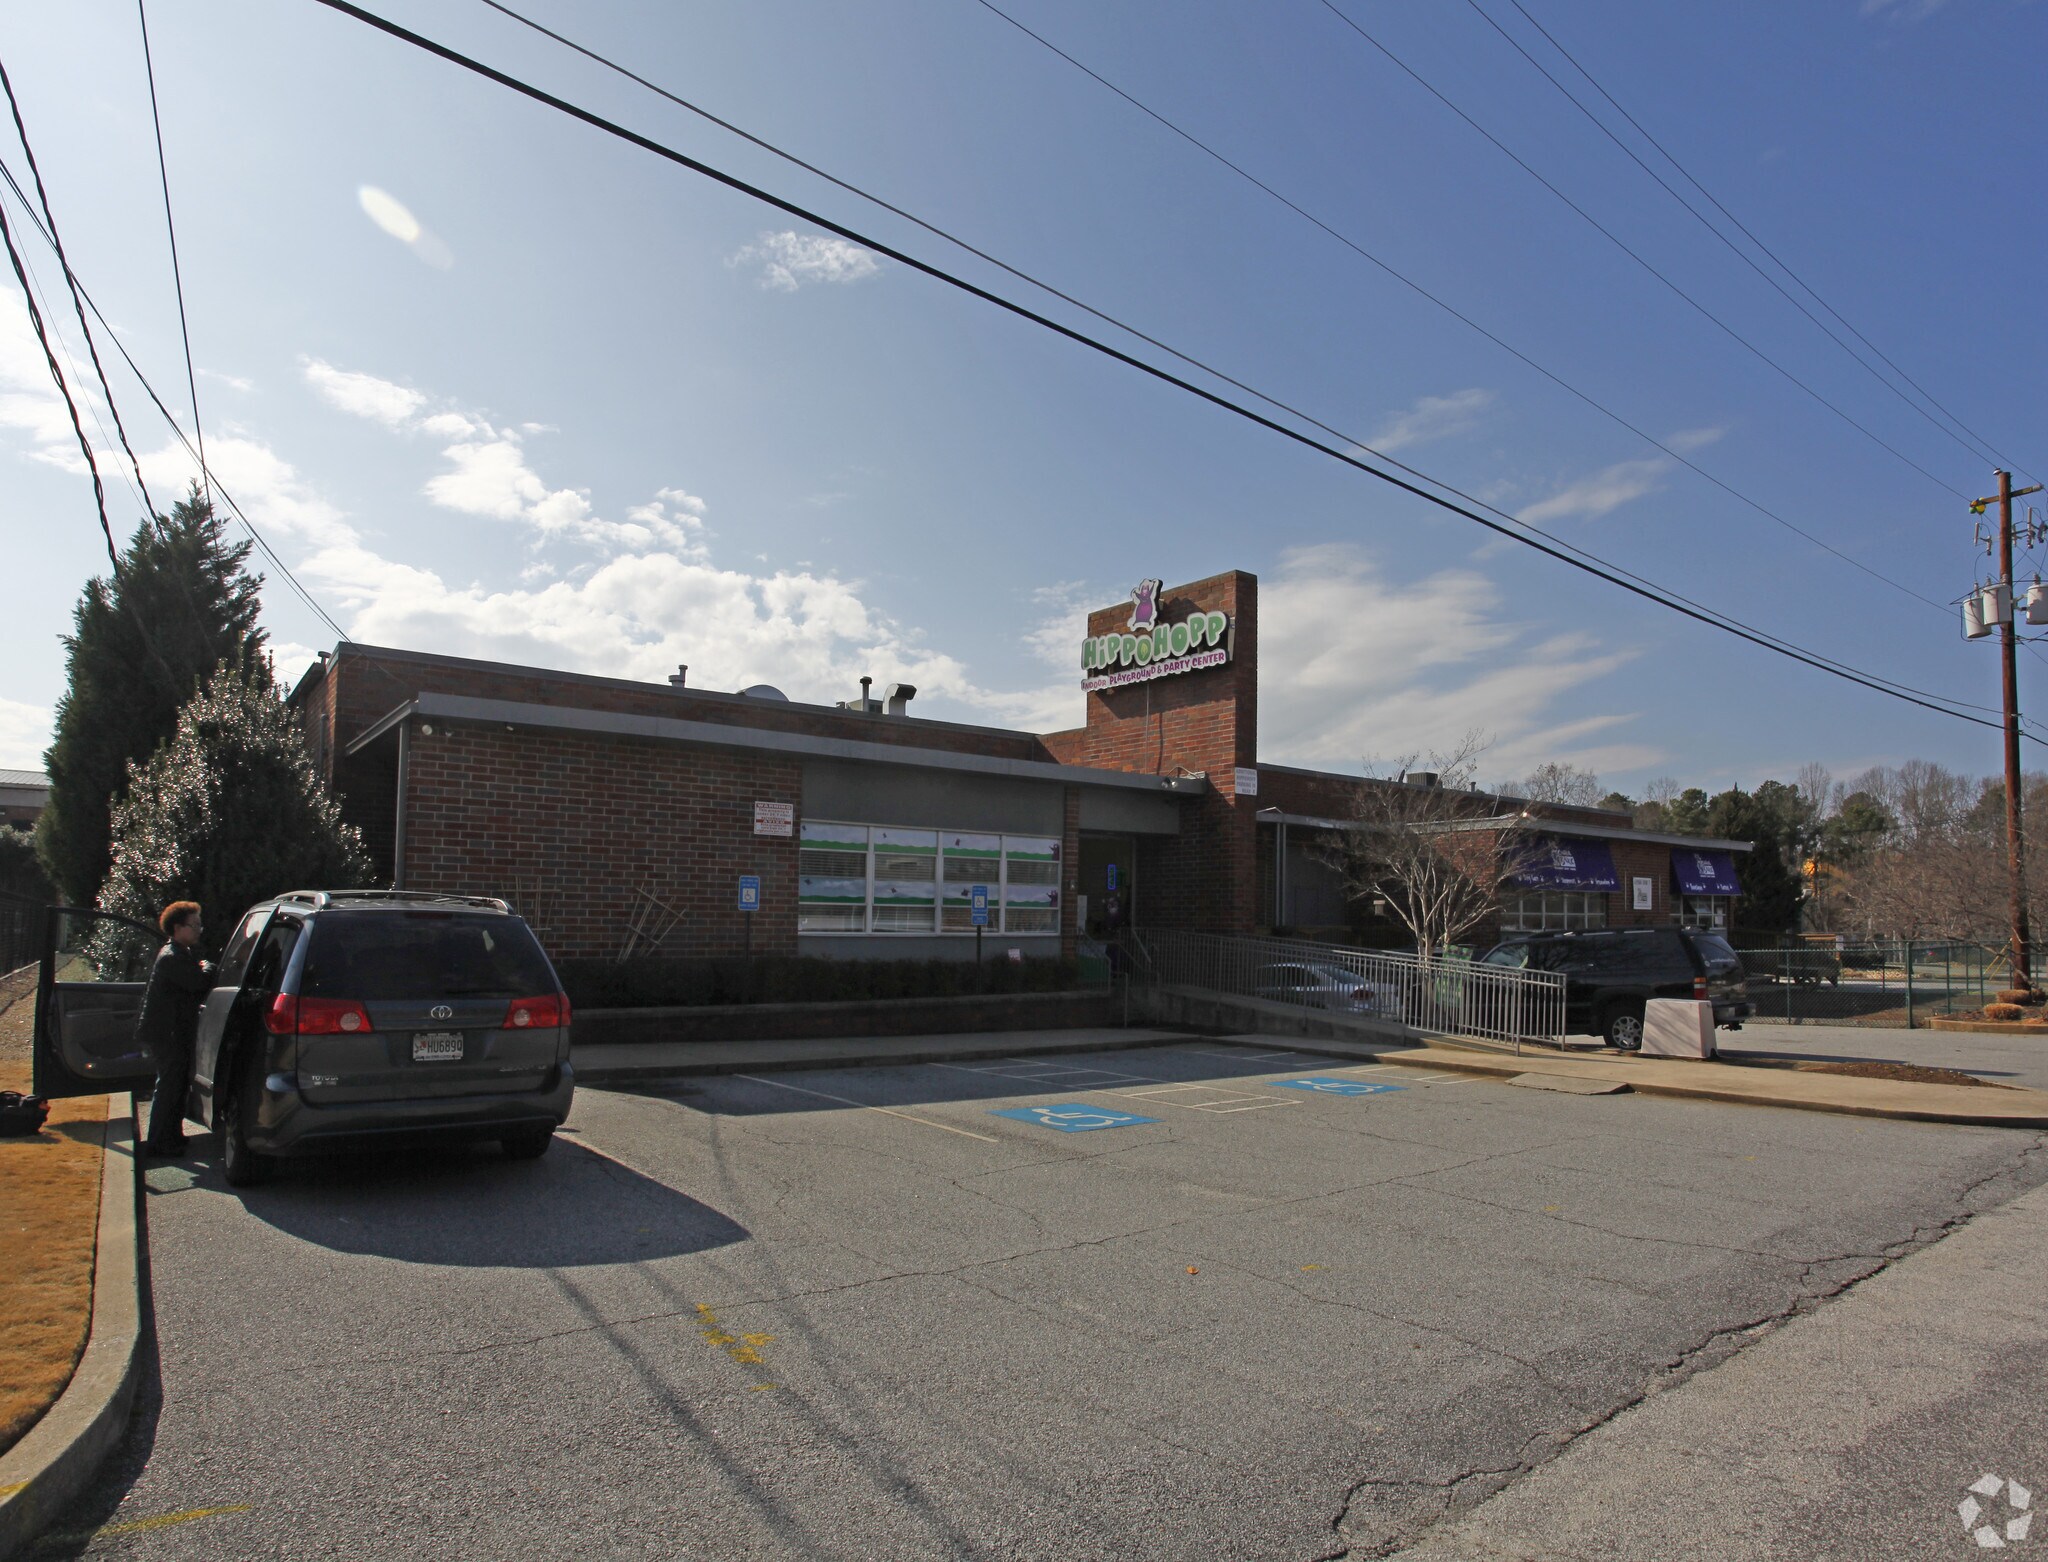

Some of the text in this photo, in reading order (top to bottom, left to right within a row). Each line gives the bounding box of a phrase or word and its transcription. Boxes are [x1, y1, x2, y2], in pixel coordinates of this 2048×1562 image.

[1082, 651, 1225, 691] INDOOR PLAYGROUND & PARTY CENTER
